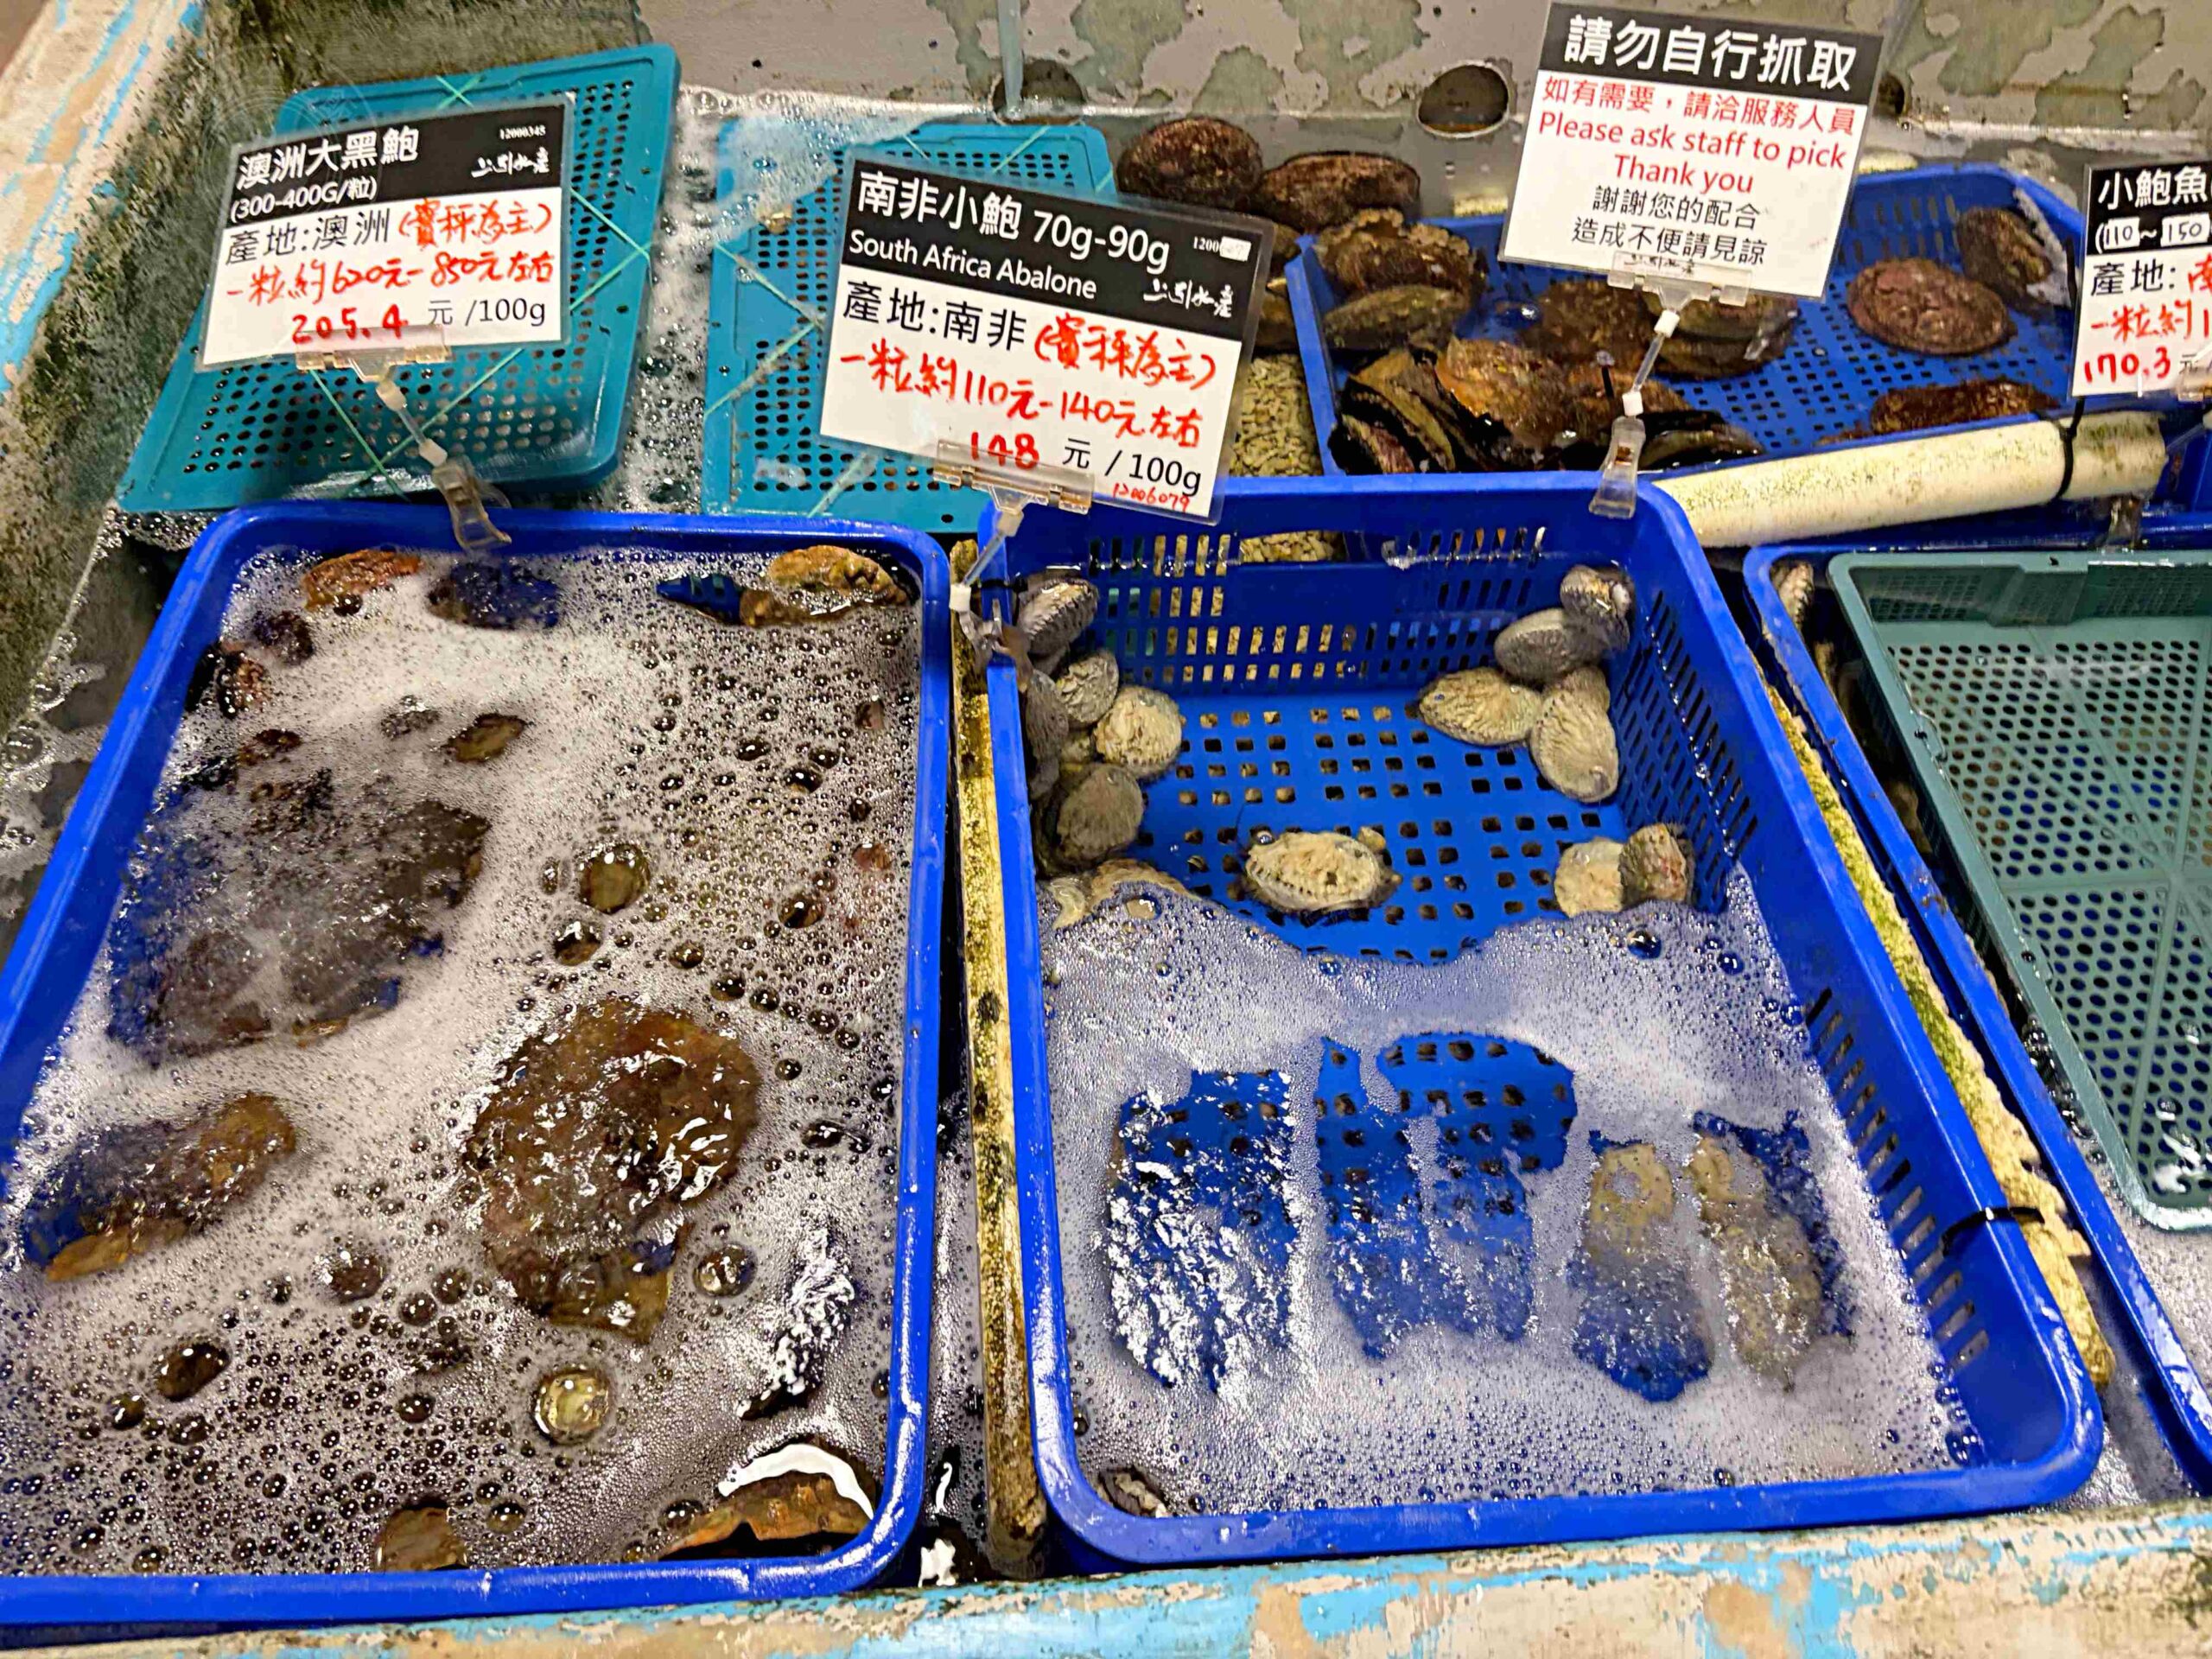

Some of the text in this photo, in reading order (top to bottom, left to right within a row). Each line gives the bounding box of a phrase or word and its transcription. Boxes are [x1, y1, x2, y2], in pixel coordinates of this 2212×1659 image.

[1564, 14, 1857, 92] 請勿自行抓取
[1541, 76, 1856, 137] 如有需要，請洽服務人員
[236, 125, 419, 191] 澳洲大黑鮑
[1539, 111, 1847, 169] Please ask staff to pick
[231, 175, 378, 223] (300-400G/粒)
[1614, 155, 1753, 194] Thank you
[225, 208, 391, 266] 產地:澳洲
[857, 171, 1170, 275] 南非小鮑 70g-90g
[1592, 185, 1761, 231] 謝謝您的配合
[849, 230, 1097, 299] South Africa Abalone
[1572, 216, 1768, 265] 造成不便請見諒
[428, 300, 453, 325] 元
[843, 280, 1027, 350] 產地:南非
[1062, 437, 1091, 469] 元
